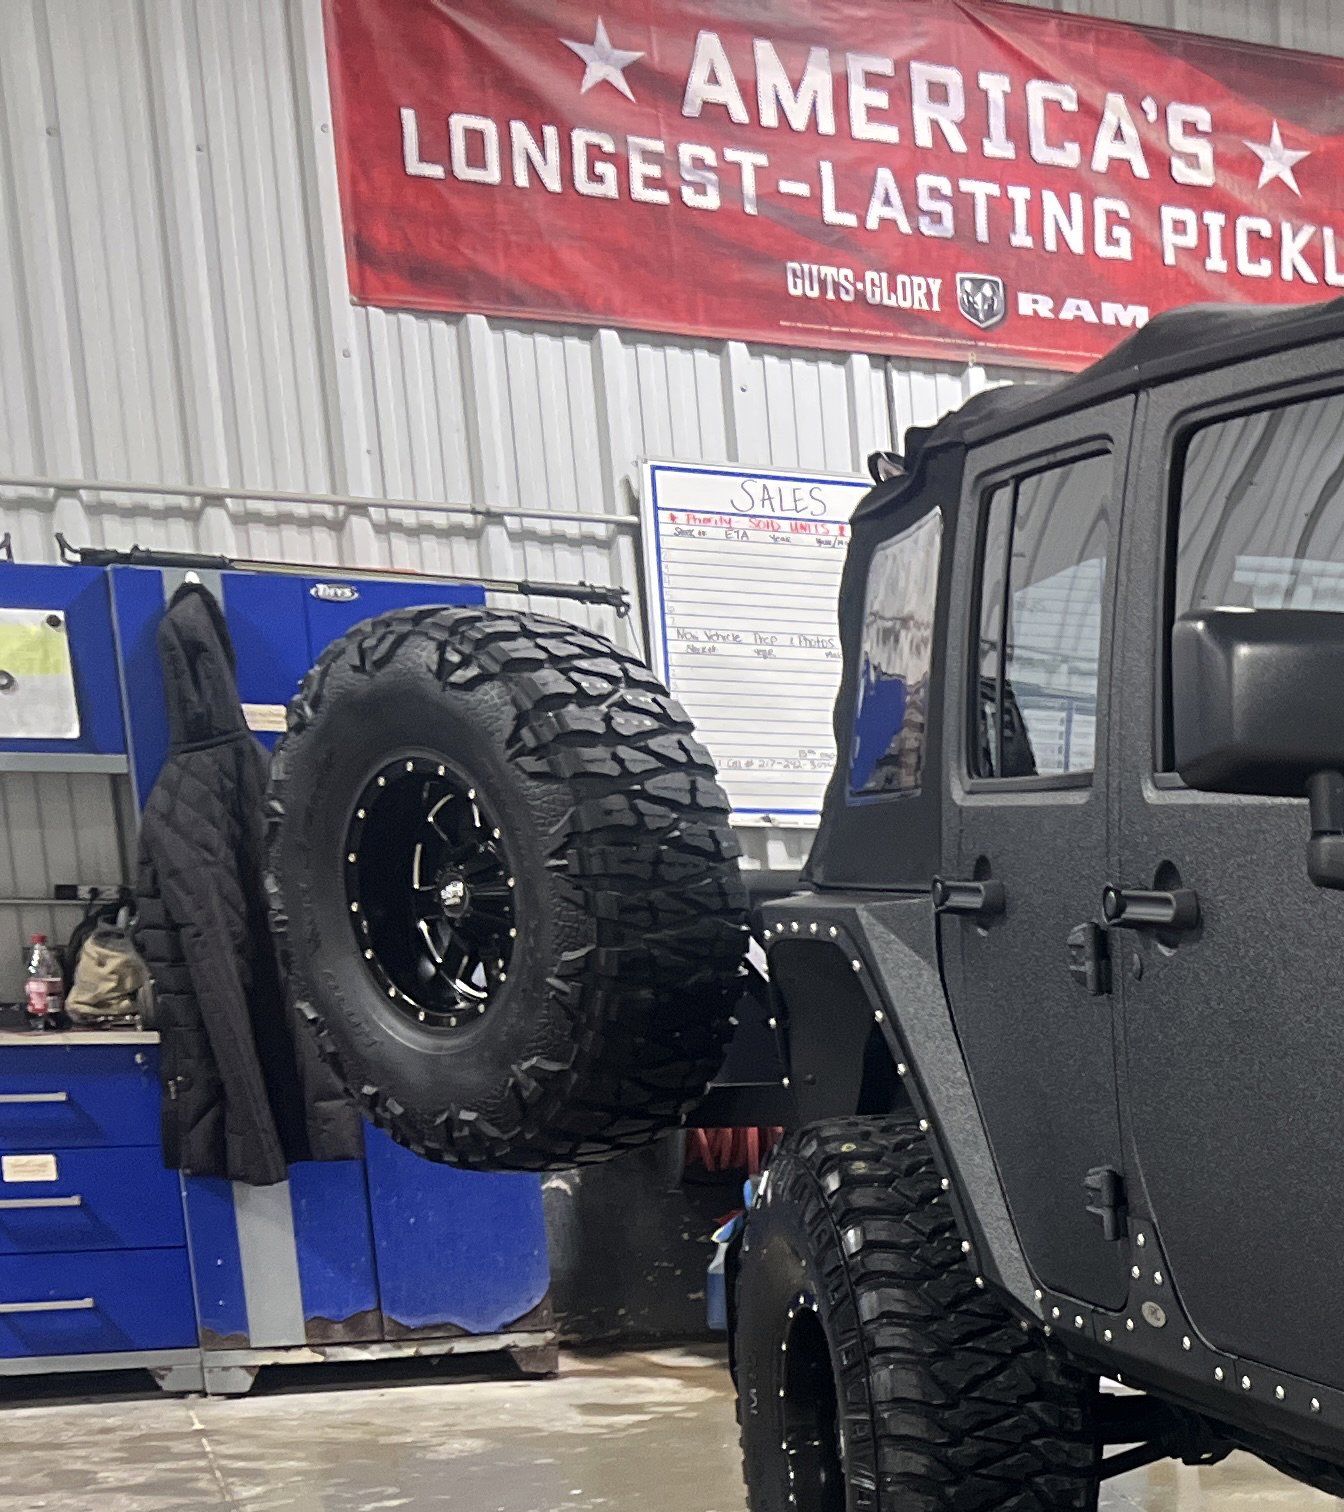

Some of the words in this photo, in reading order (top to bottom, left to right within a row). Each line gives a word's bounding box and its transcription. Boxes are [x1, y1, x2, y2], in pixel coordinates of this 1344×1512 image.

[681, 29, 1216, 188] AMERICA'S
[399, 106, 1133, 262] LONGEST-LASTING
[1016, 290, 1151, 330] RAM
[729, 478, 827, 517] SALES
[724, 529, 751, 542] ETA
